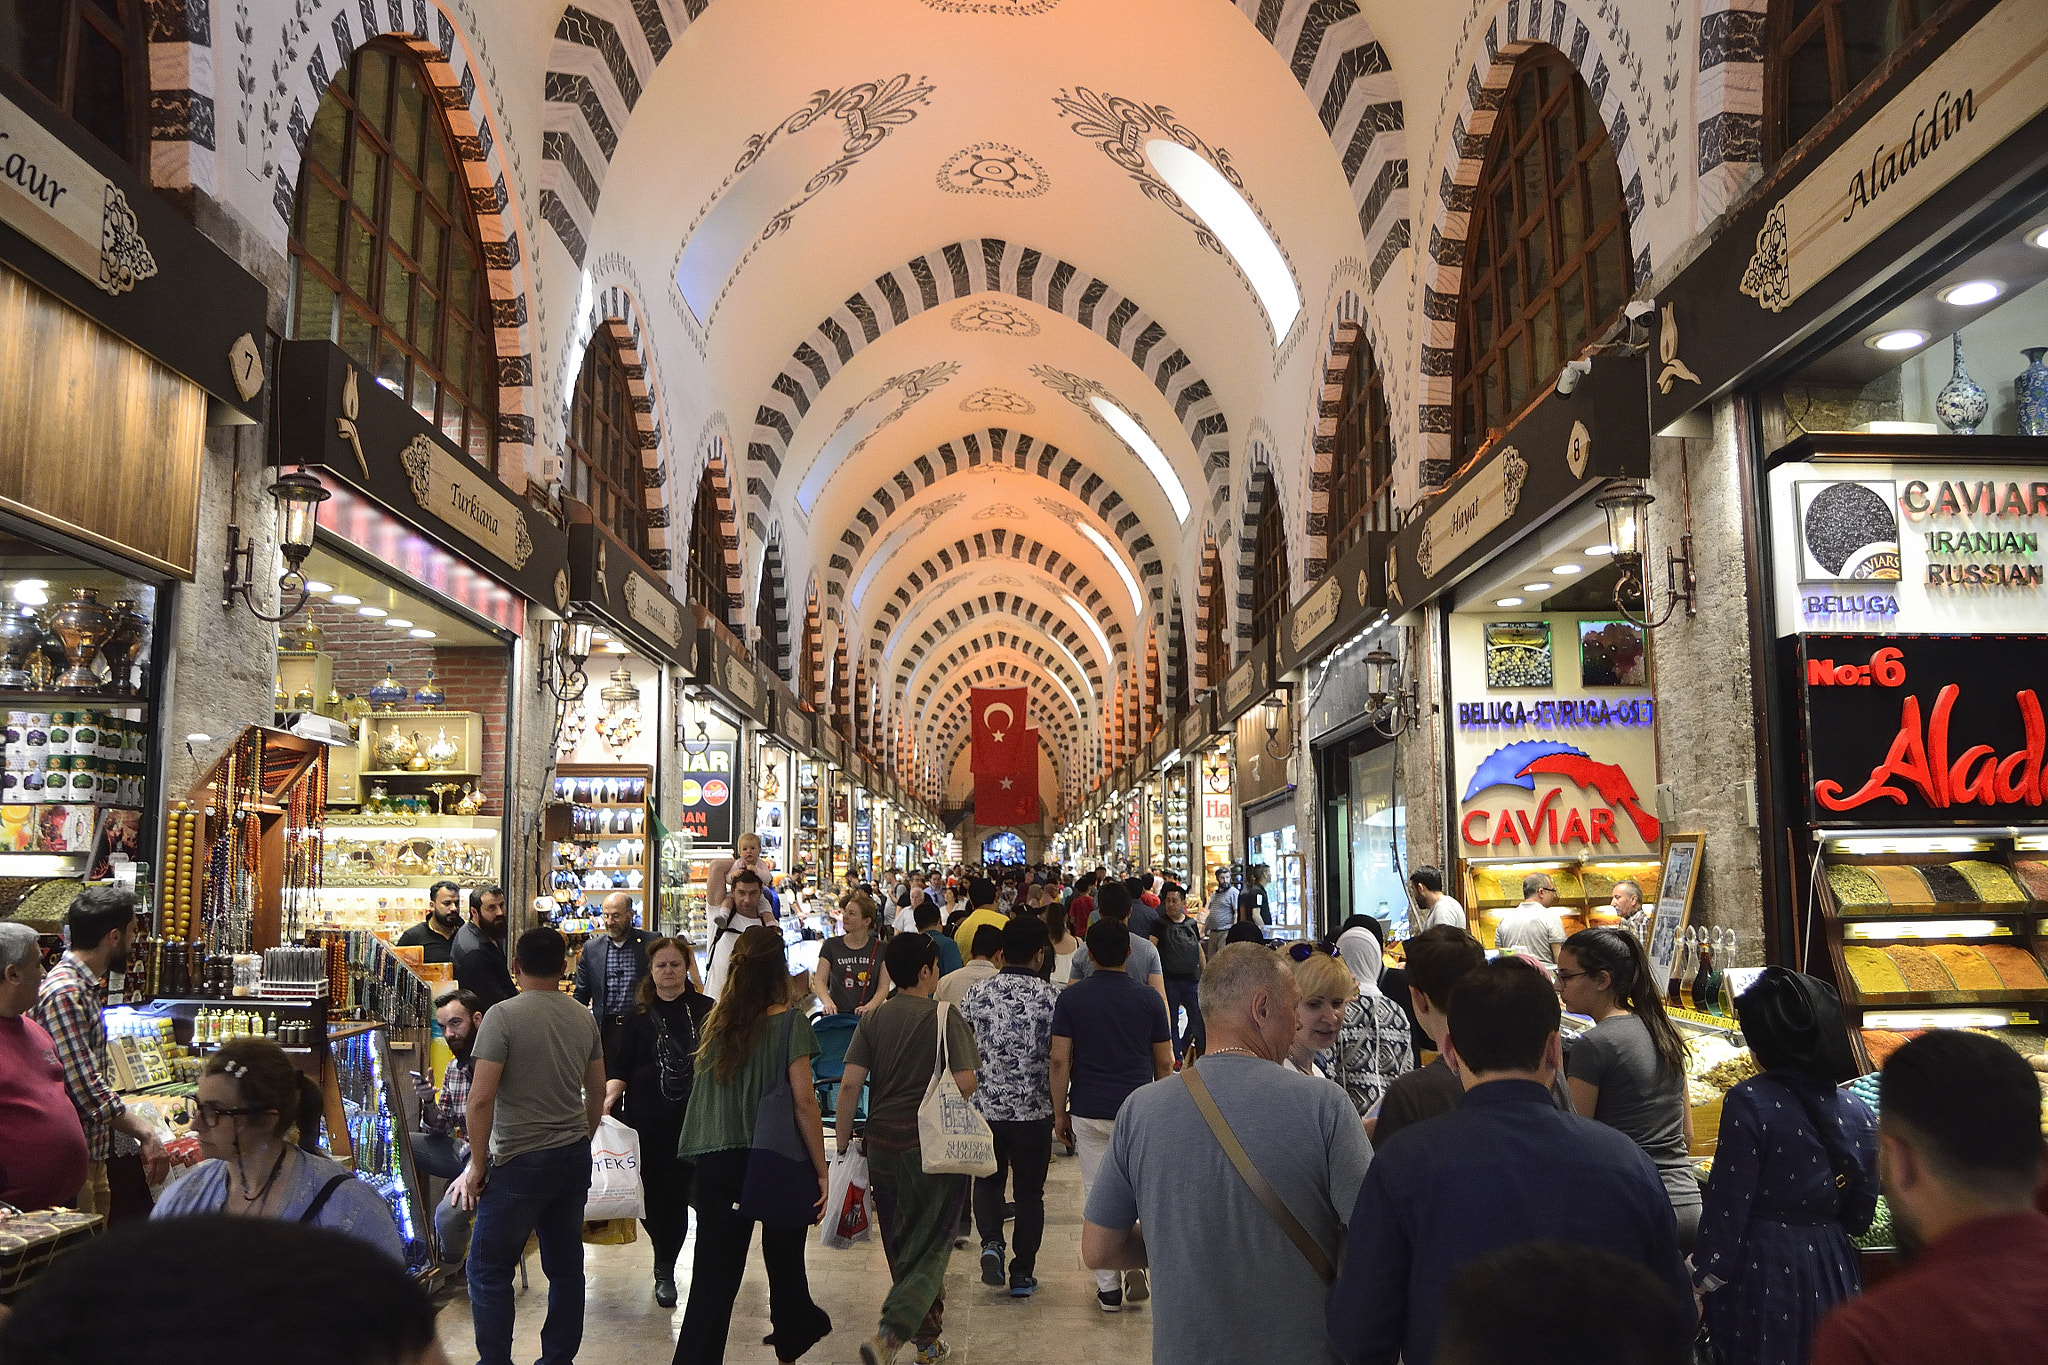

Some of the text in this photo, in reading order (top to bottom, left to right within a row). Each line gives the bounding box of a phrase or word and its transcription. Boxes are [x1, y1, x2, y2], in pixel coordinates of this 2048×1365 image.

[0, 132, 67, 209] aur
[1843, 88, 1977, 223] Aladdin
[245, 350, 254, 380] 7
[1573, 437, 1580, 462] 8
[451, 483, 498, 536] Turkiana
[1450, 495, 1479, 537] Hayat
[1902, 480, 2048, 516] CAVIAR
[1928, 531, 2038, 552] IRANIAN
[1854, 554, 1899, 579] CAVIARS
[1927, 563, 2043, 585] RUSSIAN
[1806, 595, 1900, 614] BELUGA
[1815, 683, 2048, 811] Alad
[1462, 787, 1618, 846] CAVIAR
